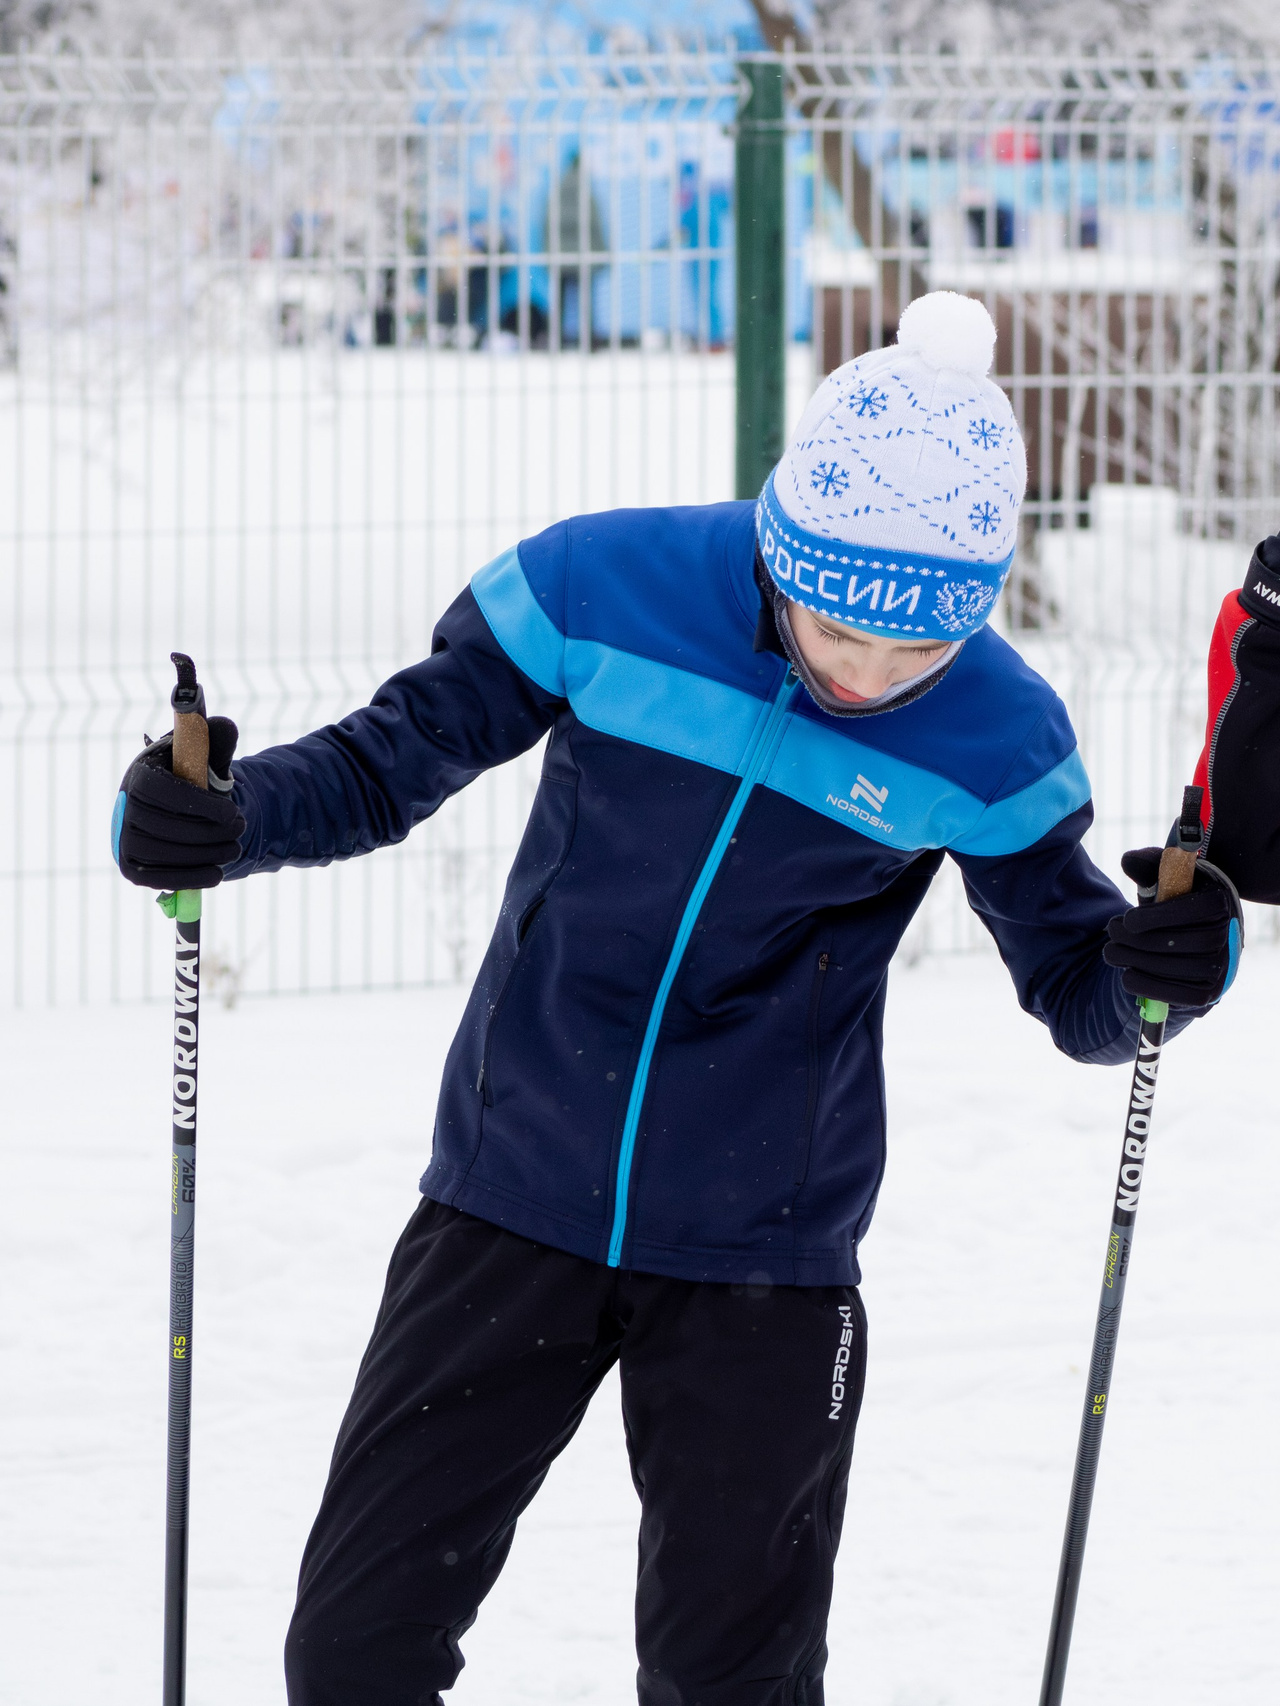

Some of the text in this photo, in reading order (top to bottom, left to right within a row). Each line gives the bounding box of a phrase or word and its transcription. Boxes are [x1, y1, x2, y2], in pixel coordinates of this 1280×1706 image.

[762, 528, 922, 616] РОССИИ
[825, 793, 894, 834] NORDSKI
[172, 928, 200, 1130] NORDWAY
[1116, 1033, 1162, 1212] NORDWAY
[1104, 1230, 1121, 1289] CARBON
[173, 1335, 187, 1360] RS
[828, 1305, 854, 1421] NORDSKI
[1092, 1394, 1107, 1415] RS
